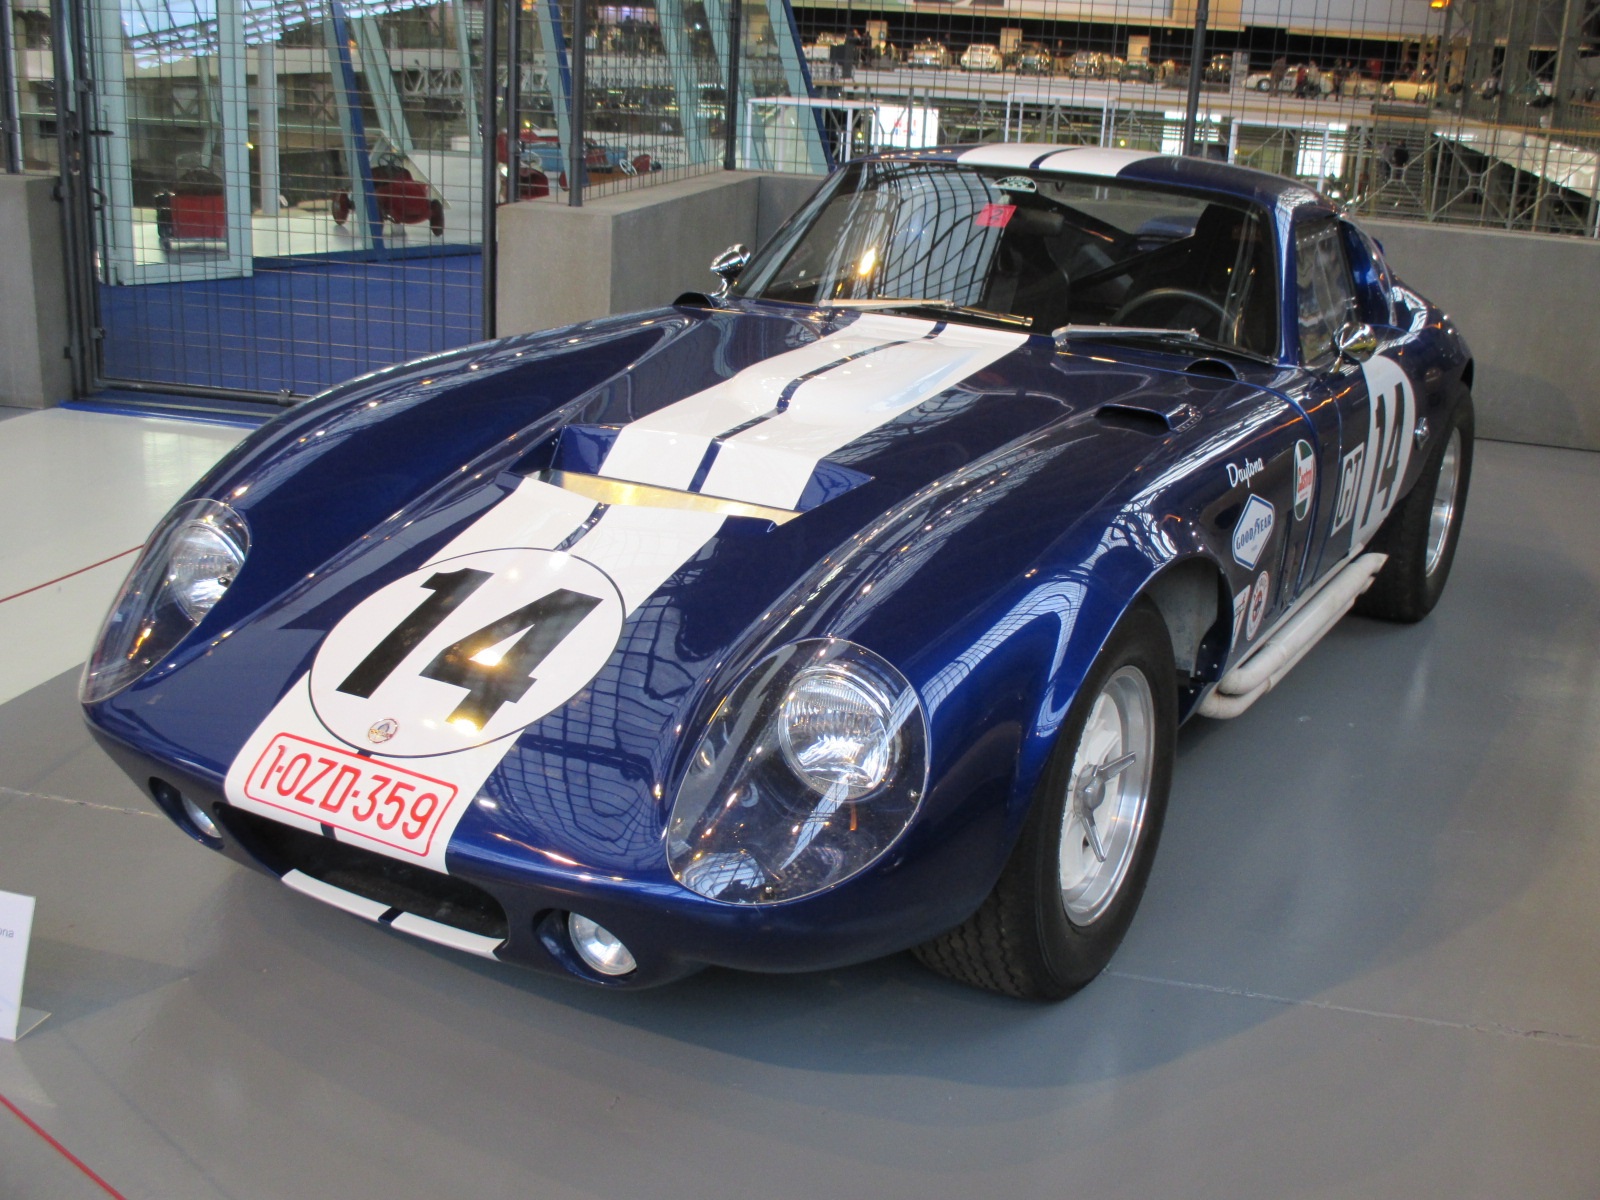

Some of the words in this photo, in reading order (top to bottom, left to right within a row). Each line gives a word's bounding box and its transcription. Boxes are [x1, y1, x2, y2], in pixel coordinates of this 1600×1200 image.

[1226, 458, 1264, 488] Daytona
[1335, 450, 1363, 528] GT
[1360, 382, 1405, 529] 14
[336, 567, 604, 735] 14
